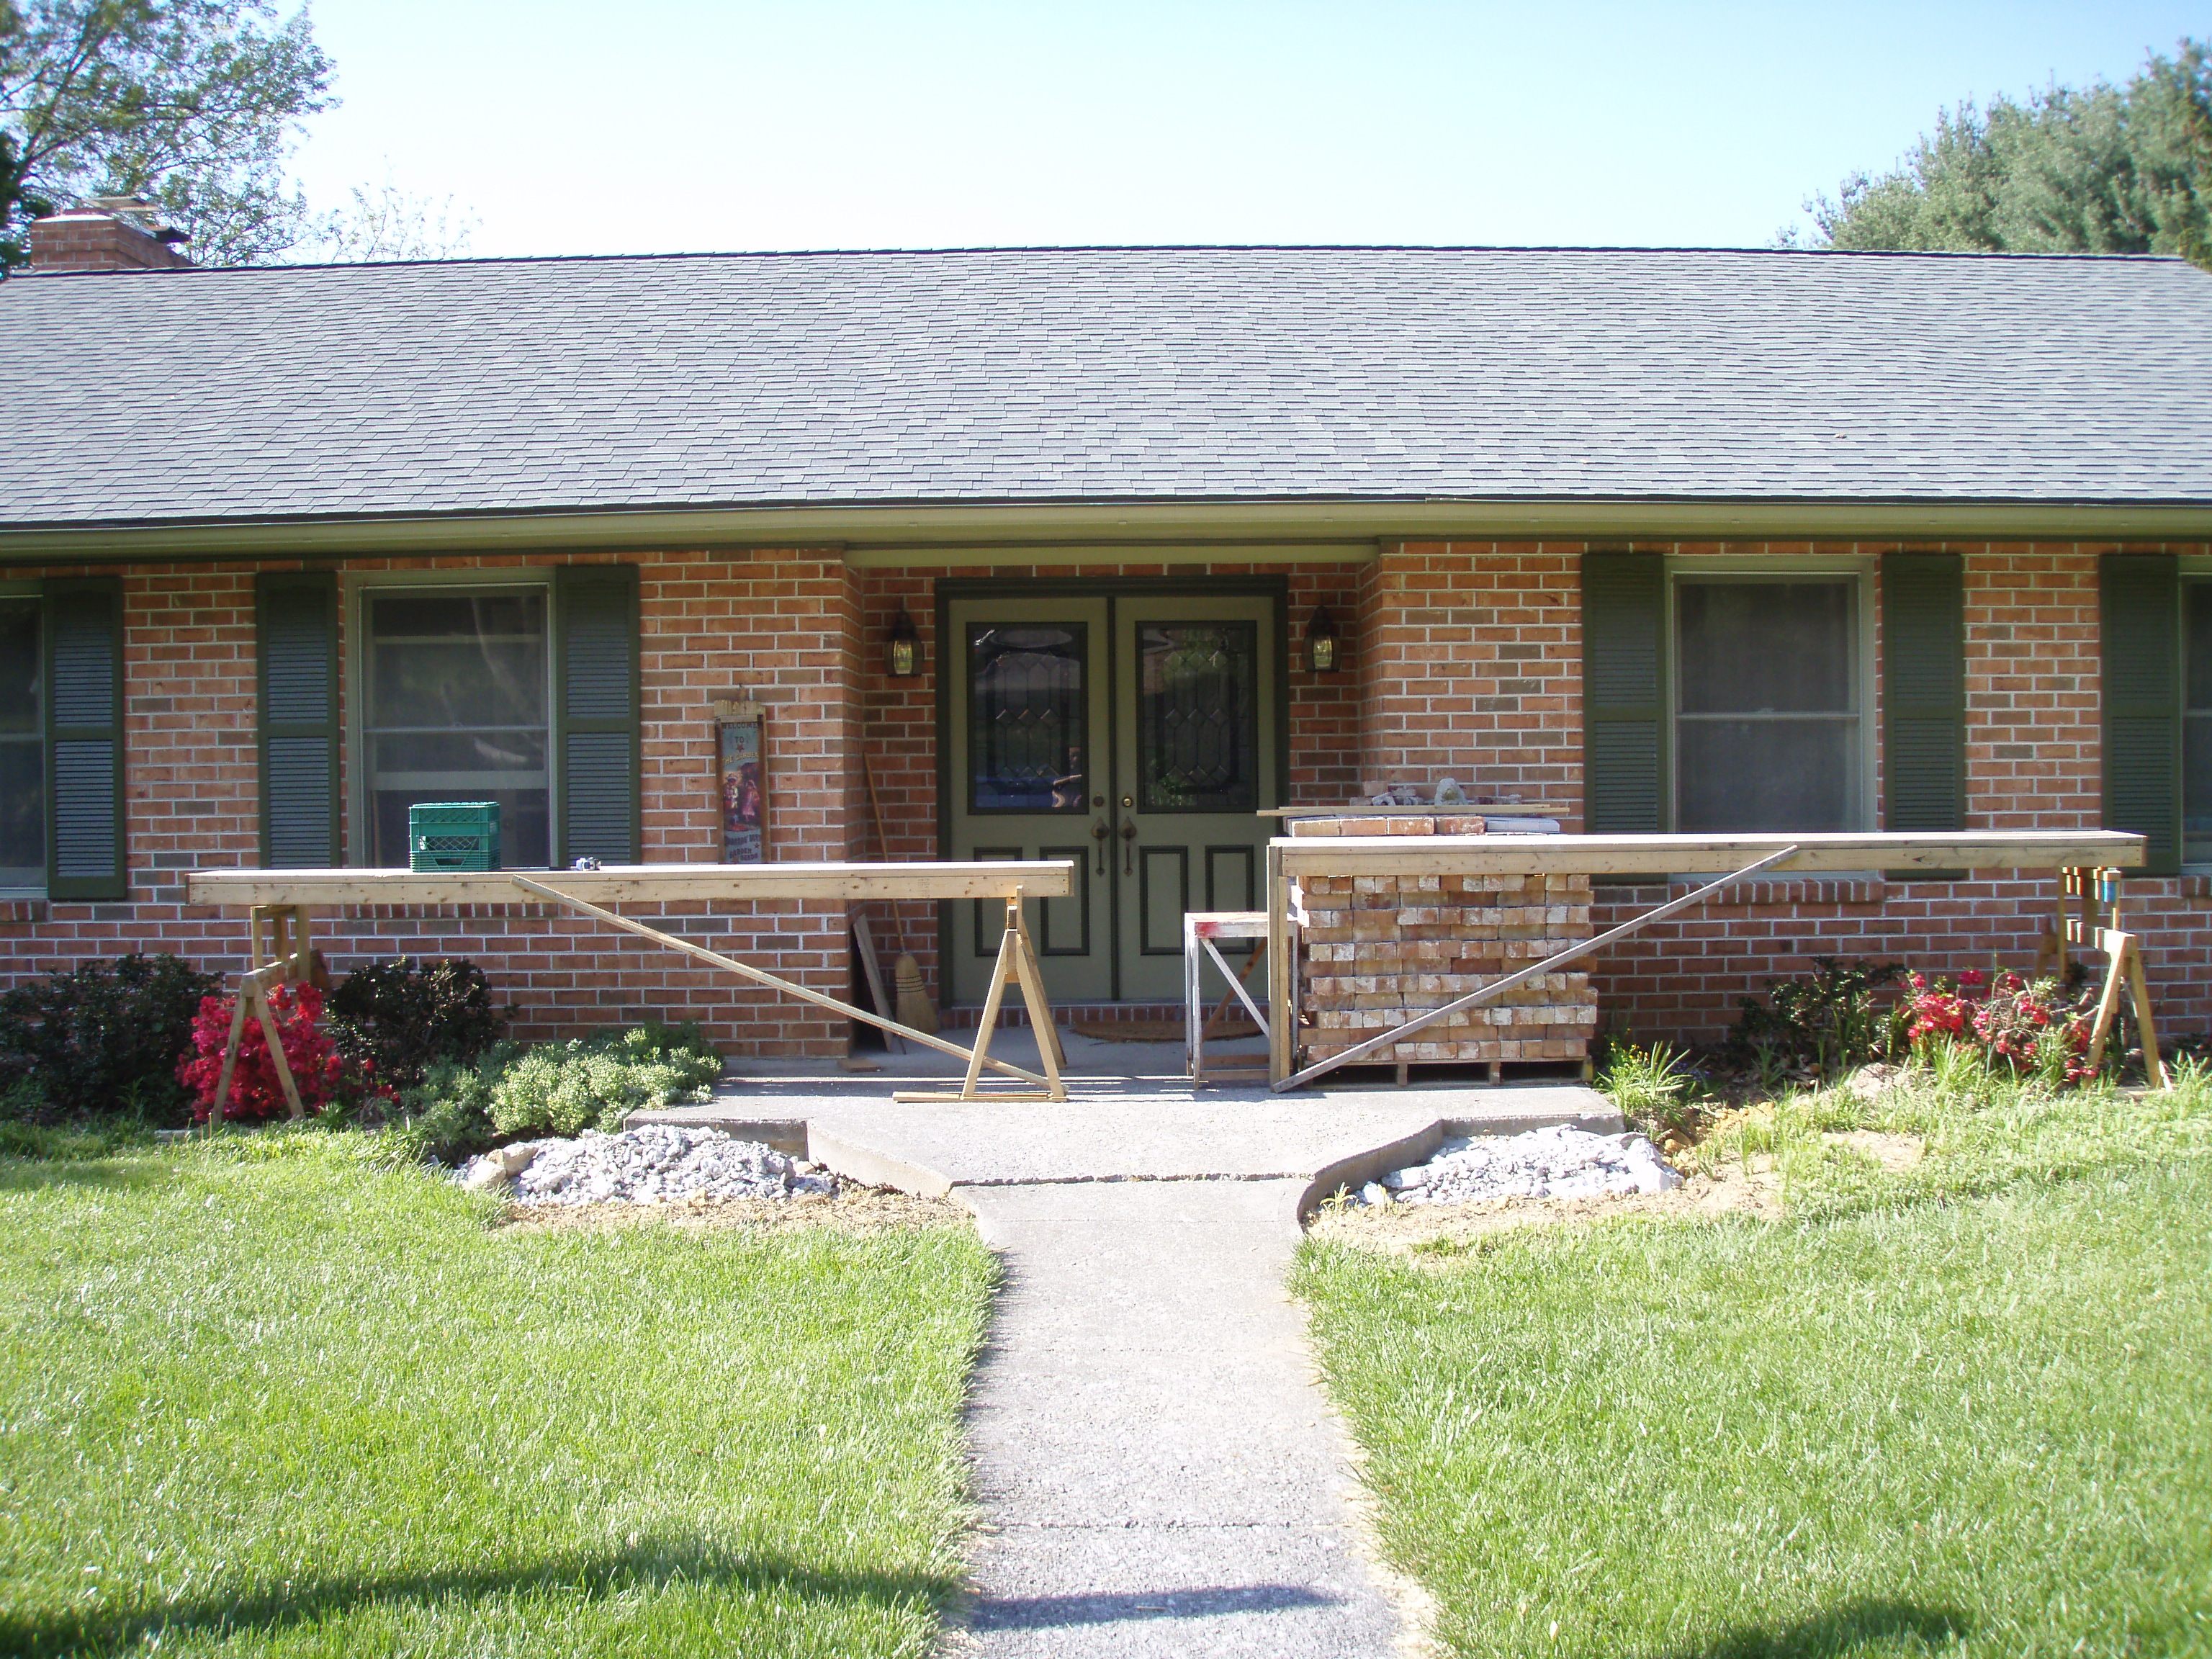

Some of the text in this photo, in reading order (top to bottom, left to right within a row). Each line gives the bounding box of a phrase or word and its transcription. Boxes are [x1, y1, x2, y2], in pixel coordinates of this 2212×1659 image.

[721, 752, 759, 764] THE GARDEN
[729, 848, 752, 858] GARDEN
